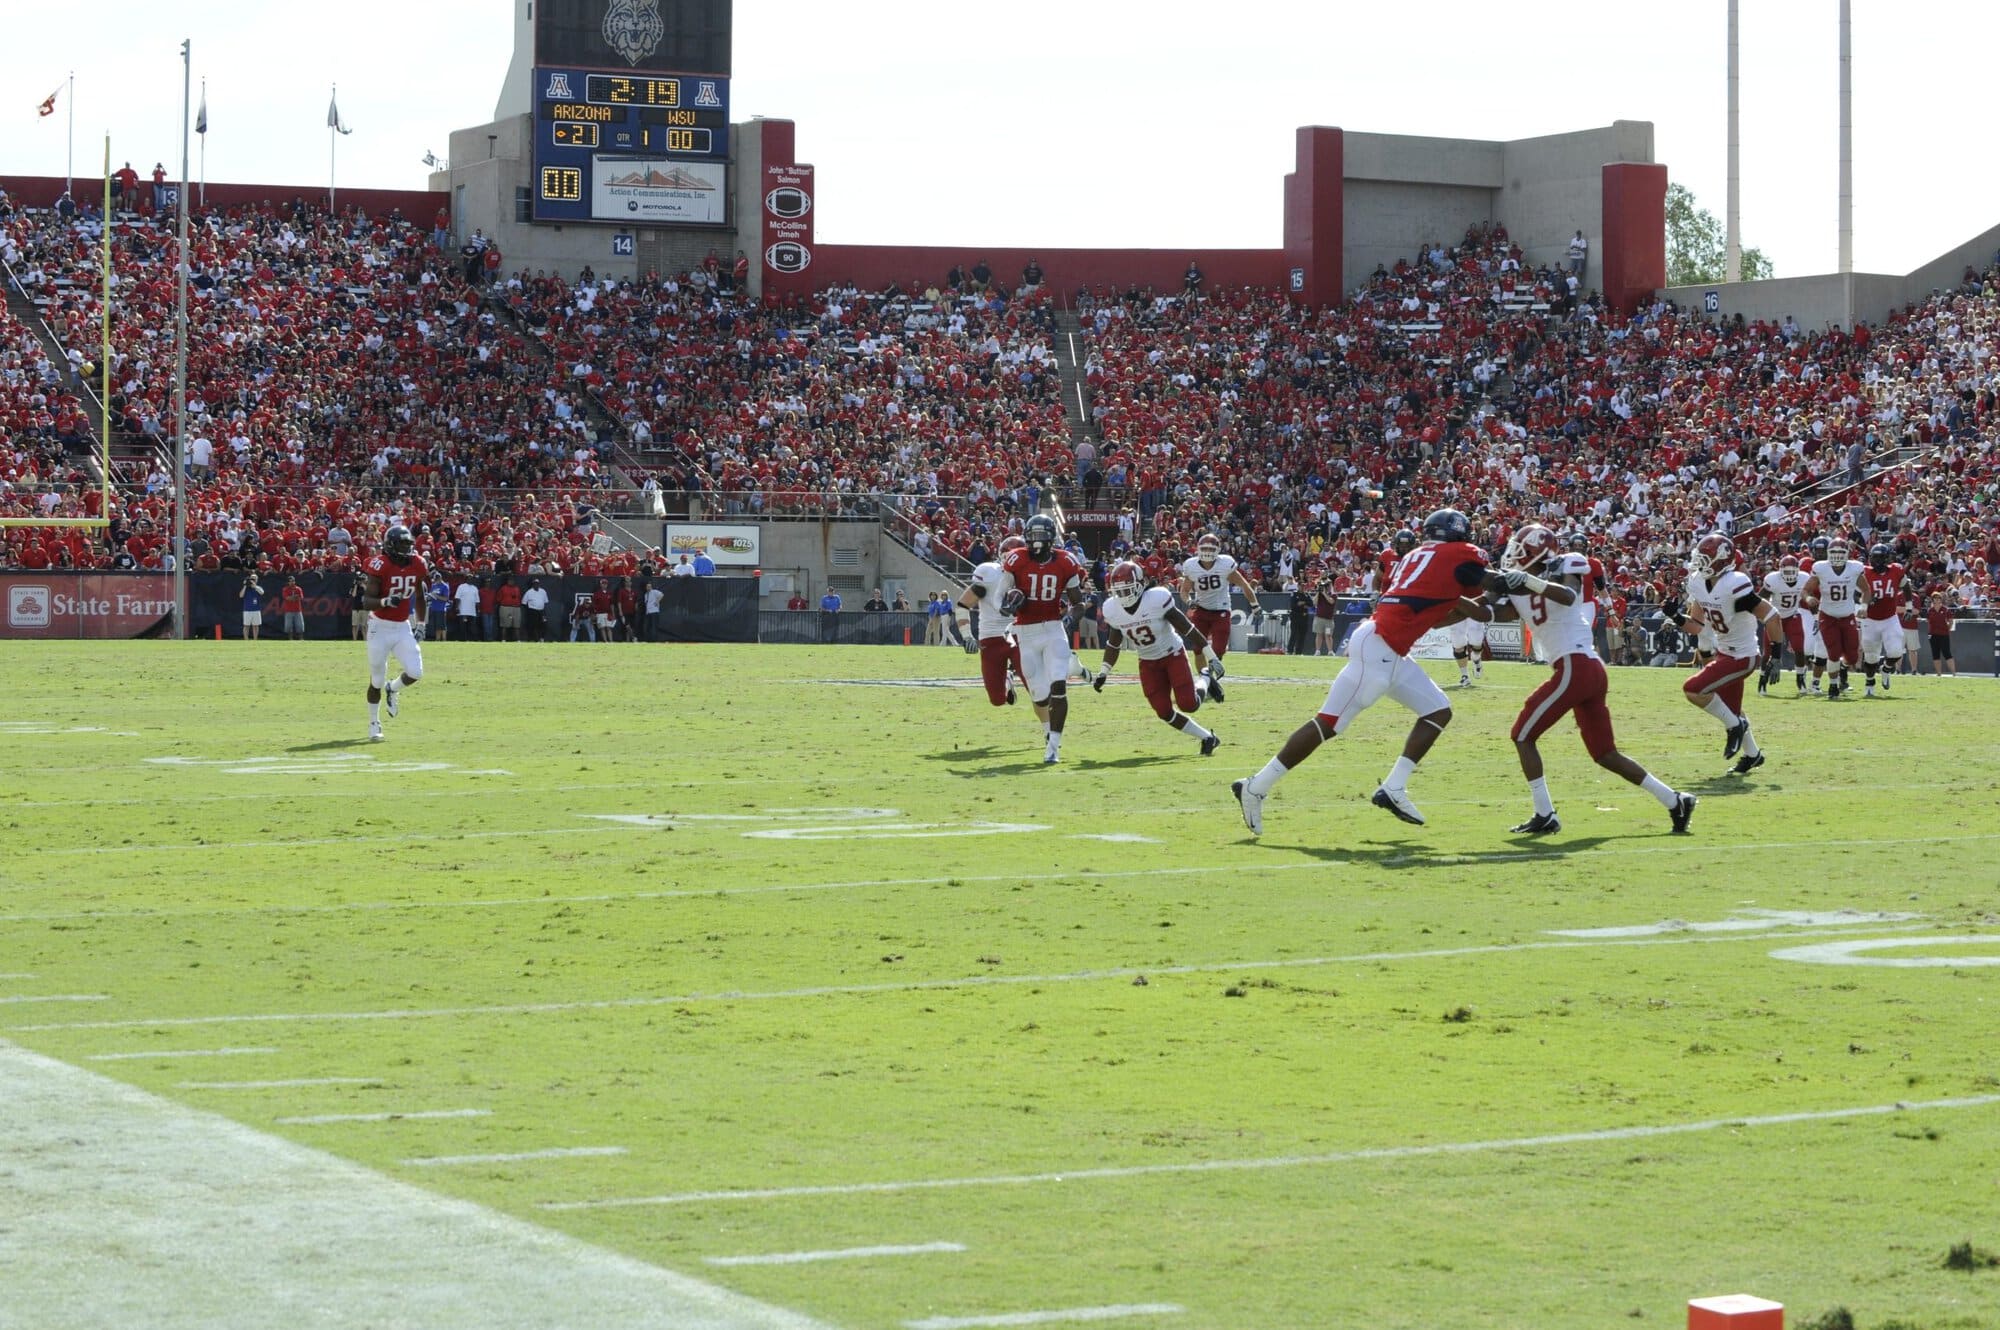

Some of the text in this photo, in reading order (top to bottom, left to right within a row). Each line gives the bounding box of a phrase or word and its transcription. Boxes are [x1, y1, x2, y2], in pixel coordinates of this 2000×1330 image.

[611, 78, 677, 105] 2:19
[554, 104, 612, 121] ARIZONA
[668, 110, 696, 125] WSU
[572, 125, 597, 145] 21
[669, 130, 693, 149] 00
[768, 166, 784, 174] John
[544, 169, 578, 198] 00
[777, 175, 801, 184] Salmon
[163, 190, 178, 205] 13
[609, 188, 632, 196] Action
[769, 221, 807, 230] McCollins
[777, 230, 800, 239] Umeh
[614, 238, 632, 253] 14
[783, 254, 794, 262] 90
[1291, 272, 1303, 288] 15
[1705, 294, 1718, 310] 16
[1081, 513, 1107, 522] SECTION
[389, 575, 416, 599] 26
[1027, 573, 1058, 601] 18
[1198, 574, 1221, 590] 96
[1872, 579, 1895, 599] 54
[1780, 594, 1798, 609] 51
[1829, 585, 1848, 602] 61
[53, 593, 178, 616] State Farm
[1529, 593, 1548, 626] 9
[1126, 624, 1157, 647] 13
